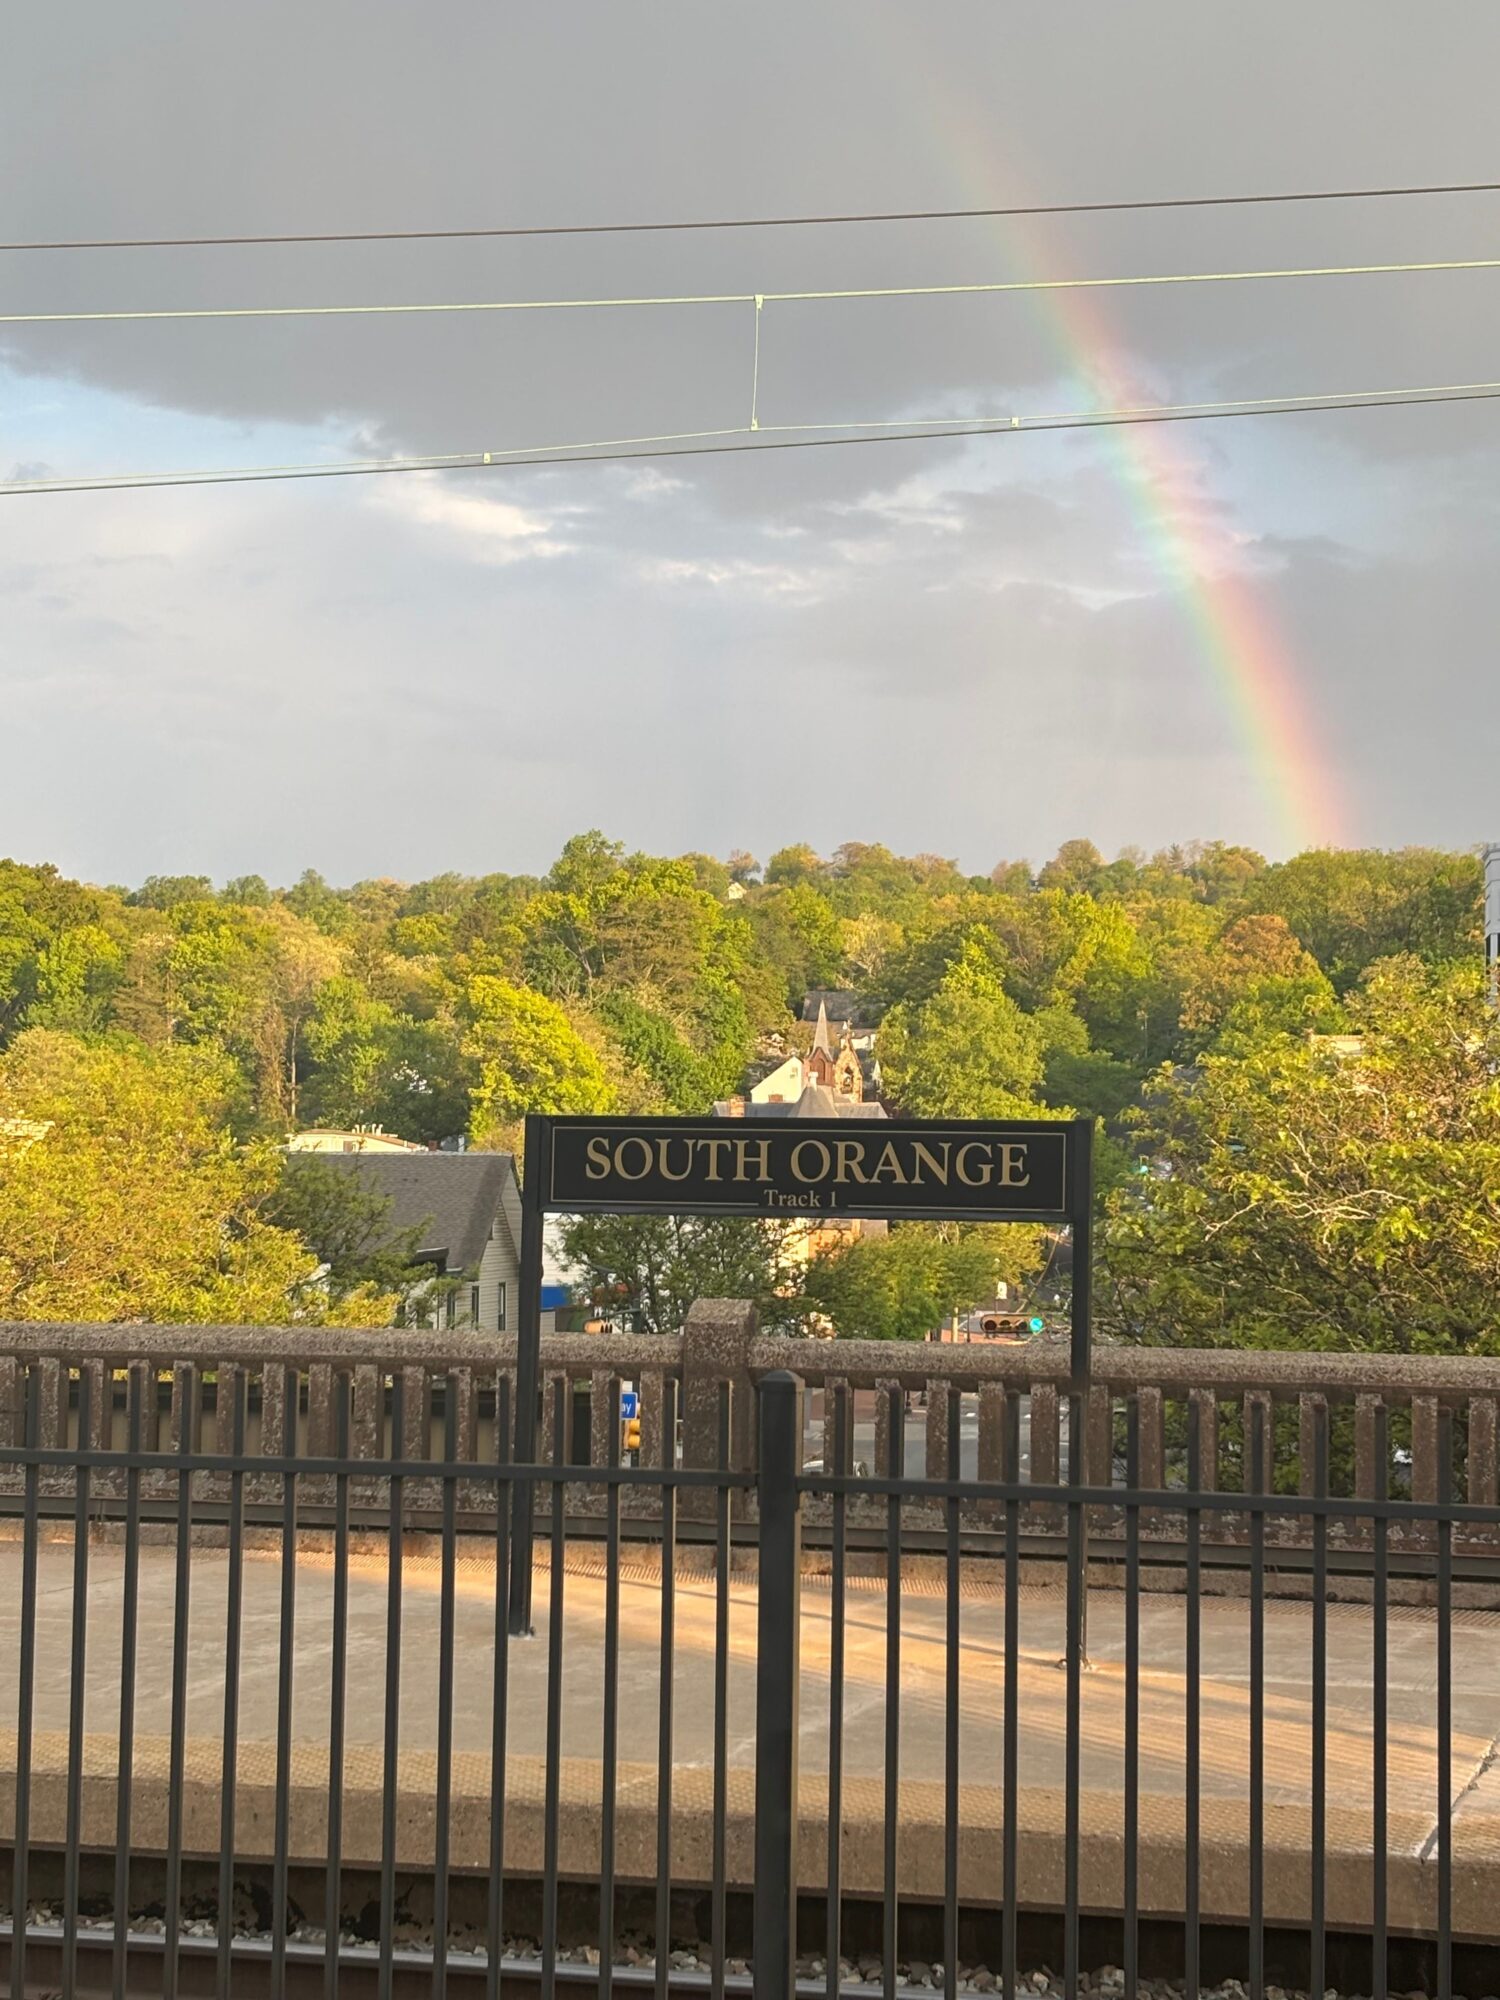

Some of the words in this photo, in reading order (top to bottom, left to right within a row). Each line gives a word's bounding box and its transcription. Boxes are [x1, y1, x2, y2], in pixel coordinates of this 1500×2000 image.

[585, 1137, 774, 1182] SOUTH
[790, 1139, 1031, 1187] ORANGE
[763, 1188, 822, 1208] Track
[829, 1190, 837, 1208] 1
